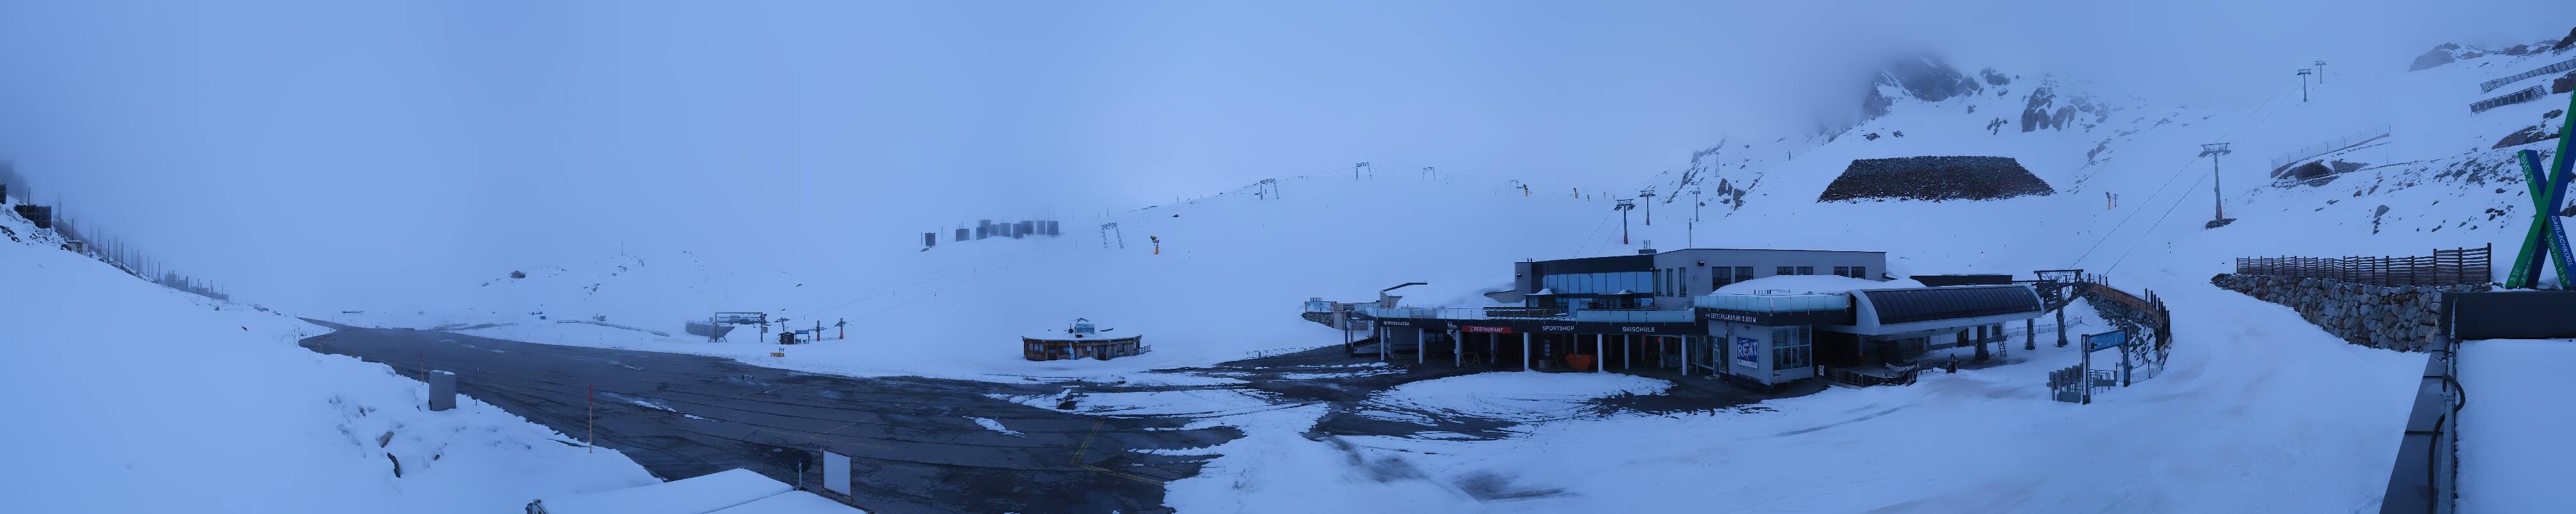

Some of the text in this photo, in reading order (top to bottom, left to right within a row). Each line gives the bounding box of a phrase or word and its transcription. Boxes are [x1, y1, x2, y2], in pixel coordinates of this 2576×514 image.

[2521, 154, 2533, 184] BIG 3
[2552, 215, 2573, 267] GAISLACHKOGL
[1737, 342, 1758, 357] RENT
